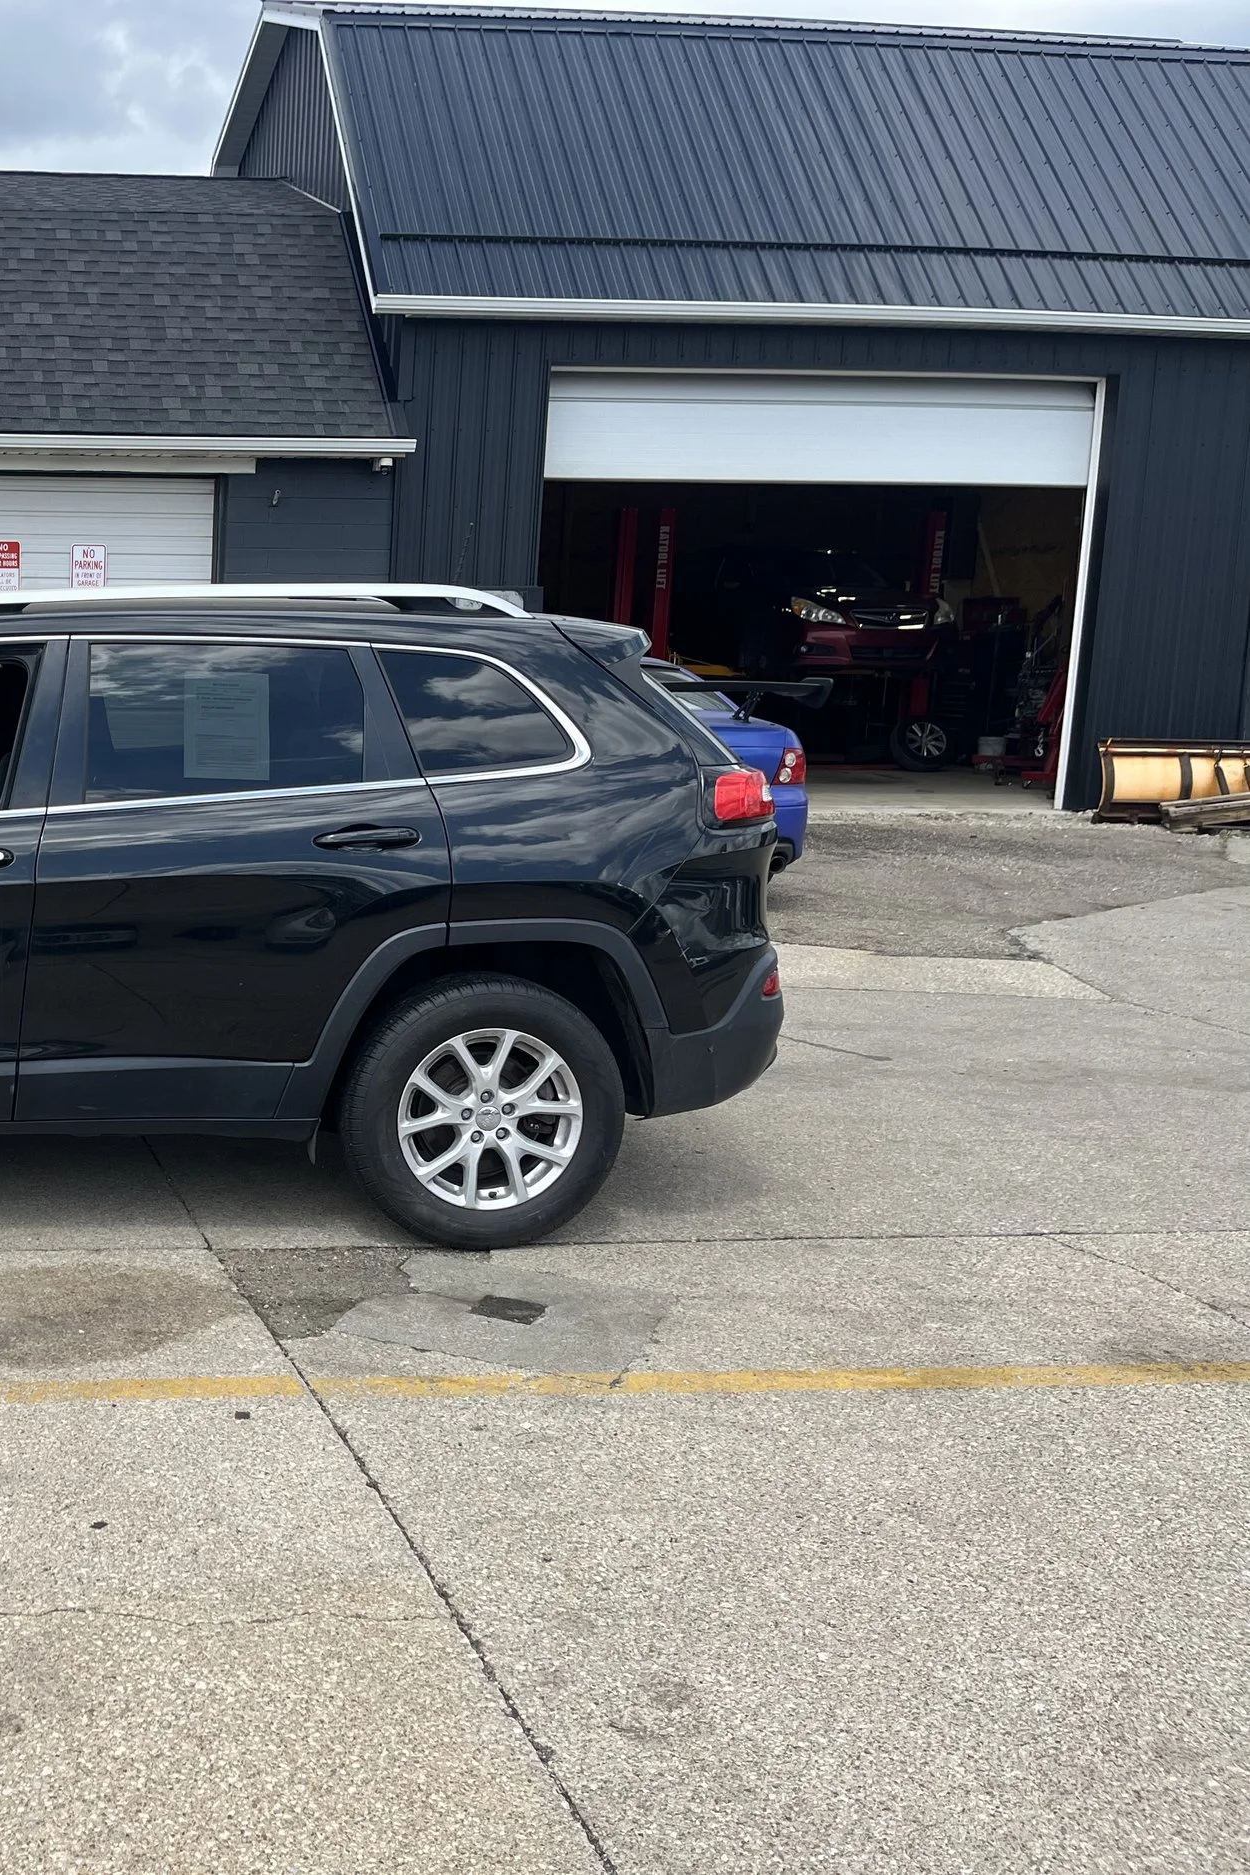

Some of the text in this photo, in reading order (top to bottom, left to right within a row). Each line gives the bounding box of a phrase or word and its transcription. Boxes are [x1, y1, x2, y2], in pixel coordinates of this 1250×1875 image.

[82, 549, 96, 559] NO
[74, 560, 103, 570] PARKING
[656, 568, 667, 590] LIFT
[929, 573, 940, 593] LIFT
